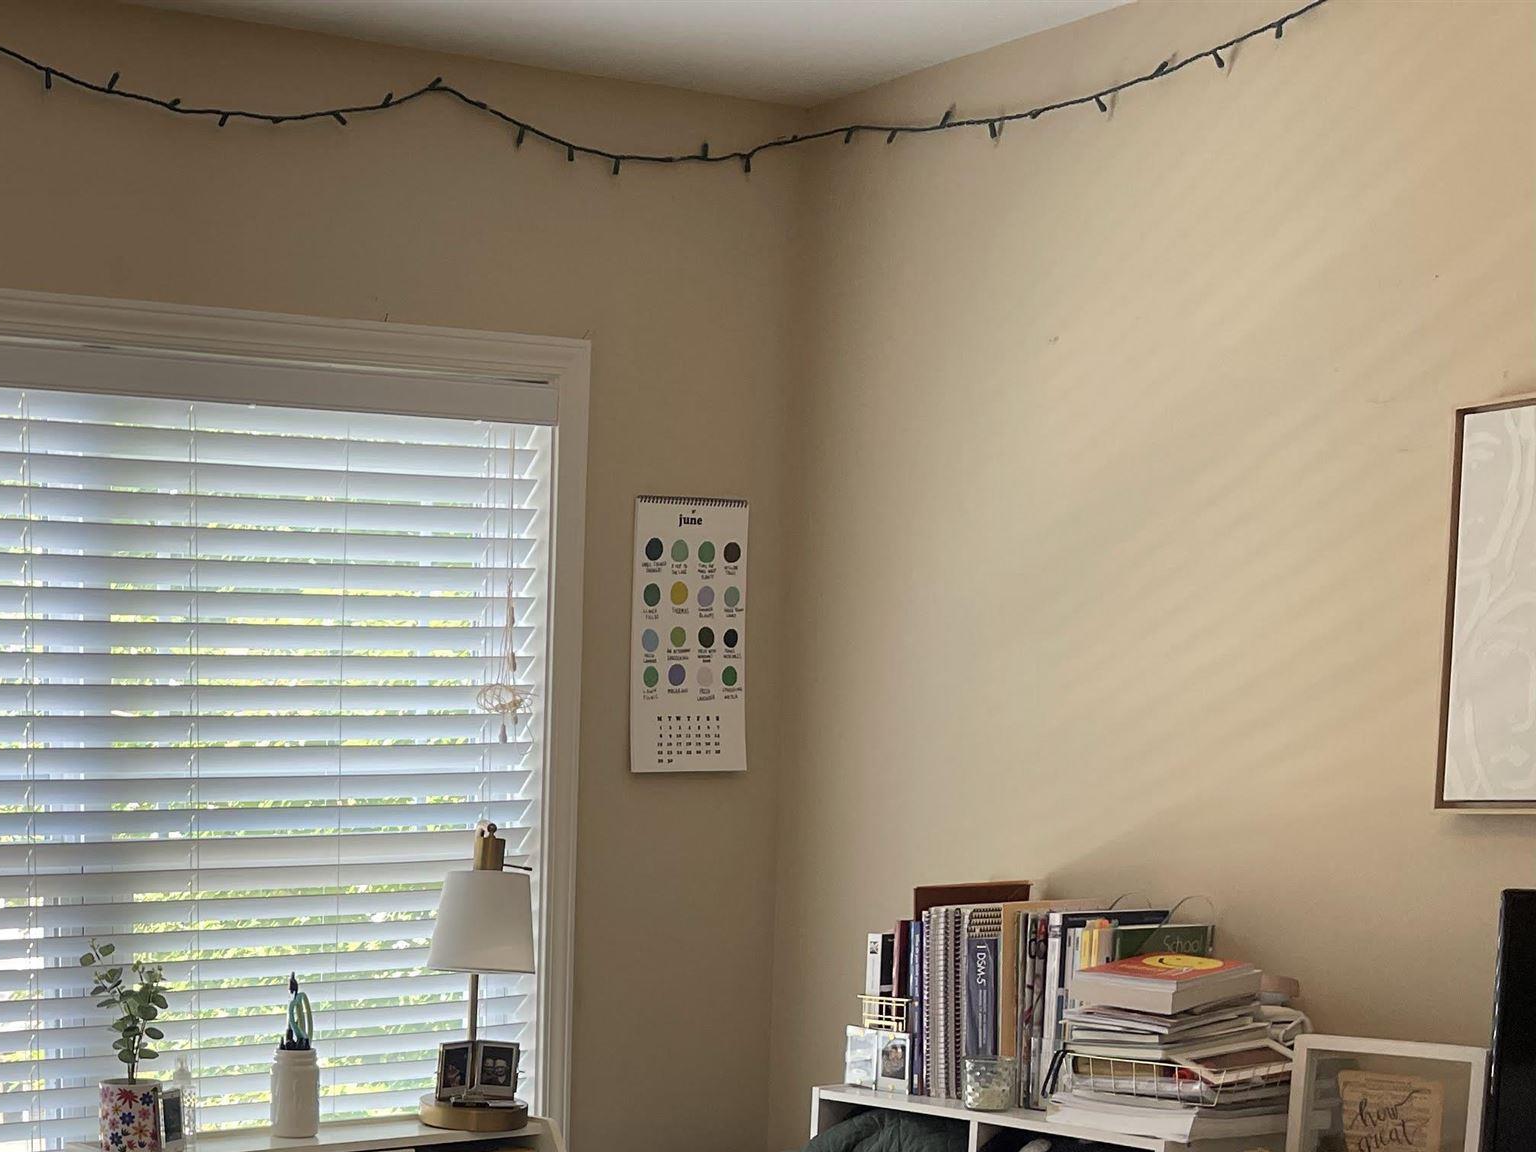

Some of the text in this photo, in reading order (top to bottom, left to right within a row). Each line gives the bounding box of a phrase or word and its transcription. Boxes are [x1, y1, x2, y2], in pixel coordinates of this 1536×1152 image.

[677, 514, 703, 527] june
[1163, 934, 1203, 953] School
[975, 952, 987, 985] DSM-5
[1348, 1090, 1419, 1129] how
